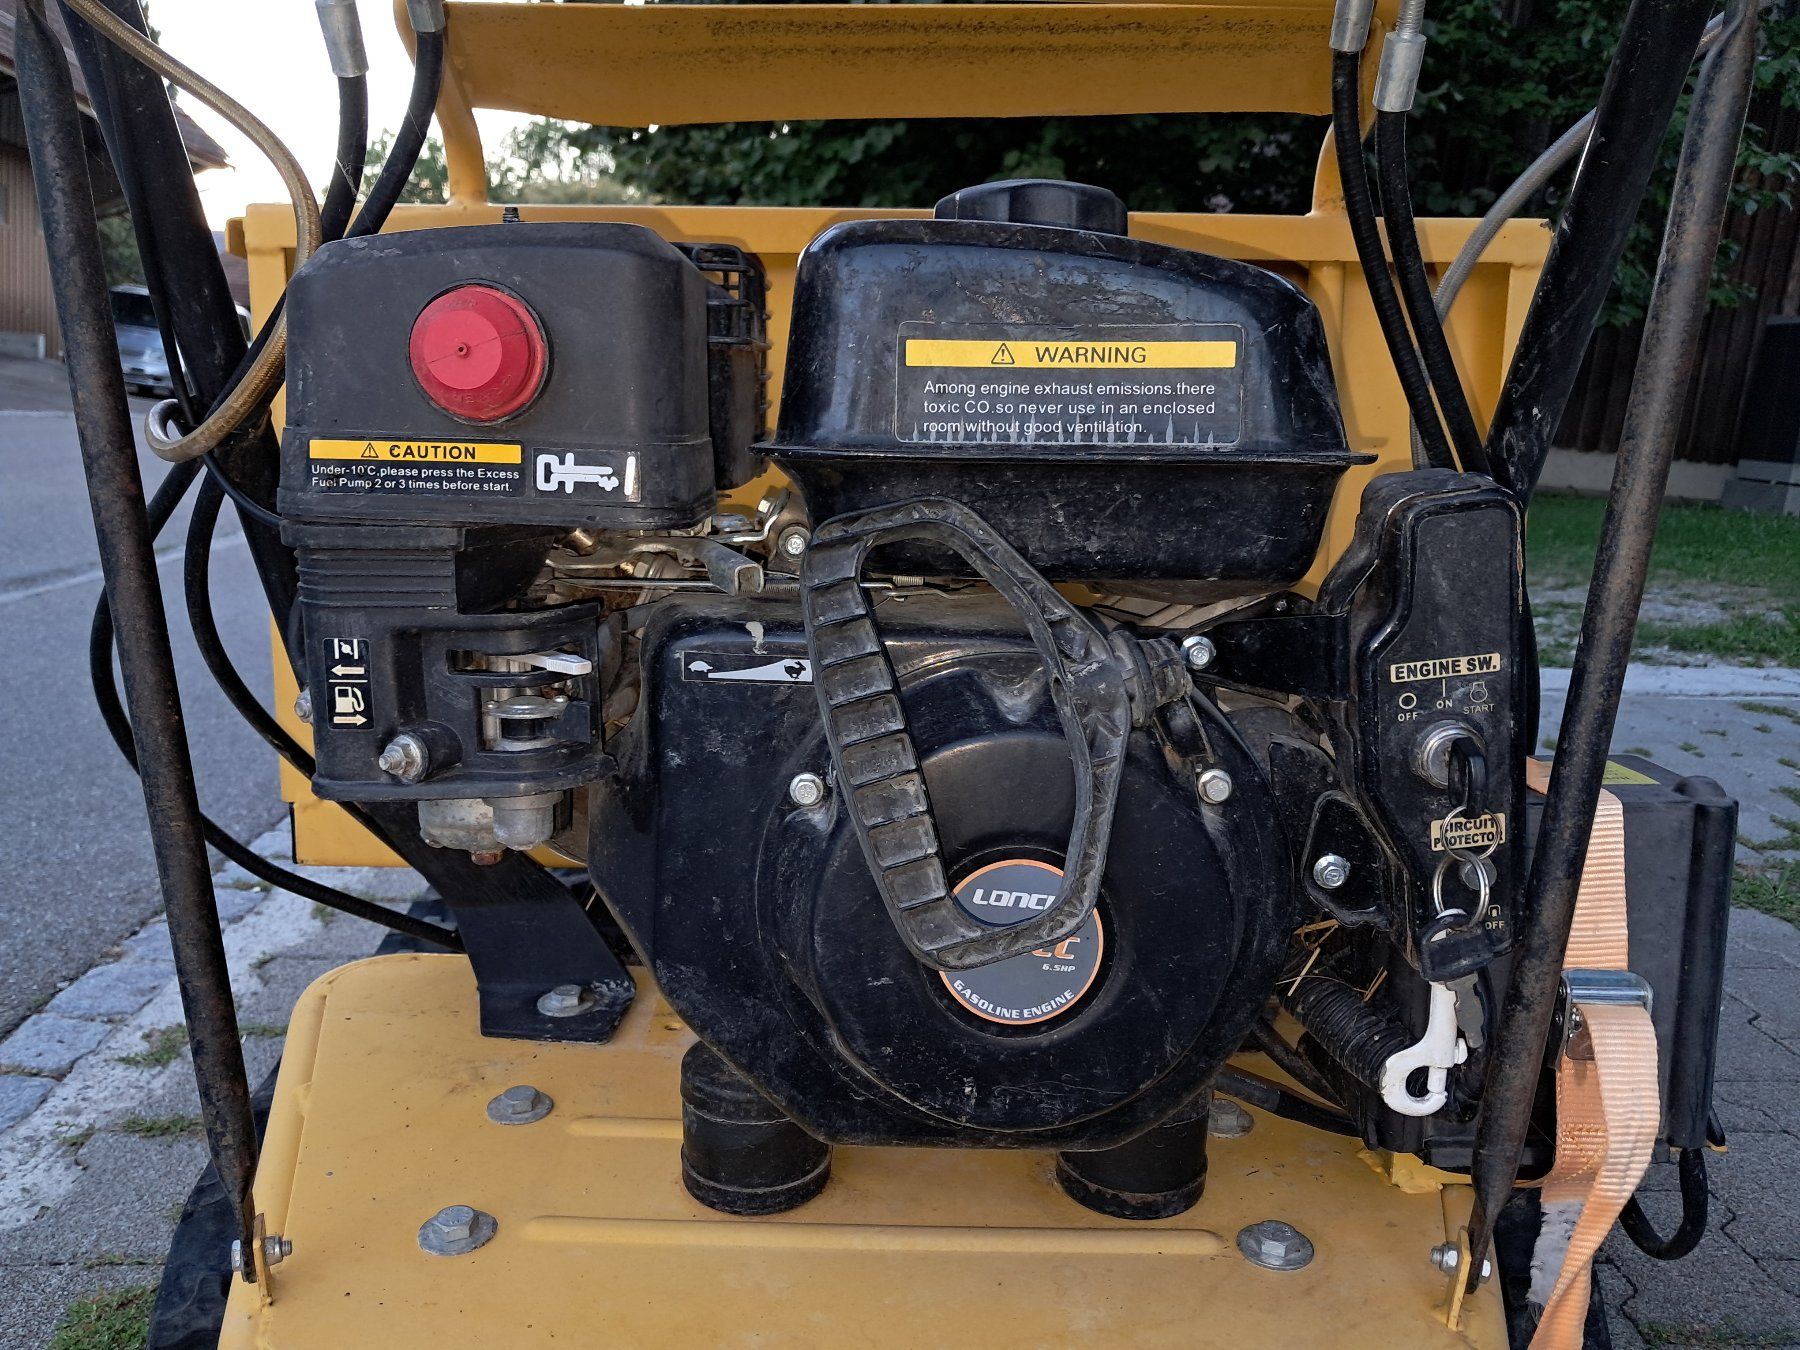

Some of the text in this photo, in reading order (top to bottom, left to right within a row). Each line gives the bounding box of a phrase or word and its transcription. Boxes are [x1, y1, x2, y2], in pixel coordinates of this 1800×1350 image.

[1035, 346, 1147, 363] WARNING
[923, 380, 976, 397] Among
[980, 381, 1030, 398] engine
[1034, 382, 1093, 395] exhaust
[923, 400, 960, 413] toxic
[1018, 403, 1063, 414] never
[1068, 403, 1096, 414] use
[1101, 401, 1114, 414] in
[1119, 403, 1138, 414] an
[1142, 401, 1215, 414] enclosed
[923, 420, 1148, 435] room without good ventilation.
[389, 444, 476, 460] CAUTION
[421, 469, 454, 478] press
[456, 468, 475, 478] the
[477, 468, 520, 480] Excess
[312, 477, 337, 487] Fuel
[339, 478, 373, 489] Pump
[374, 479, 382, 488] 2
[398, 479, 406, 489] 3
[408, 479, 440, 489] times
[442, 480, 481, 491] before
[482, 482, 513, 492] start.
[1395, 656, 1497, 680] ENGINE SW.
[1436, 699, 1453, 710] ON
[1463, 703, 1495, 715] START
[1397, 711, 1418, 722] OFF
[1485, 920, 1505, 930] OFF
[1042, 963, 1076, 972] 6.5HP
[953, 979, 1075, 1019] GASOLINE ENGINE
